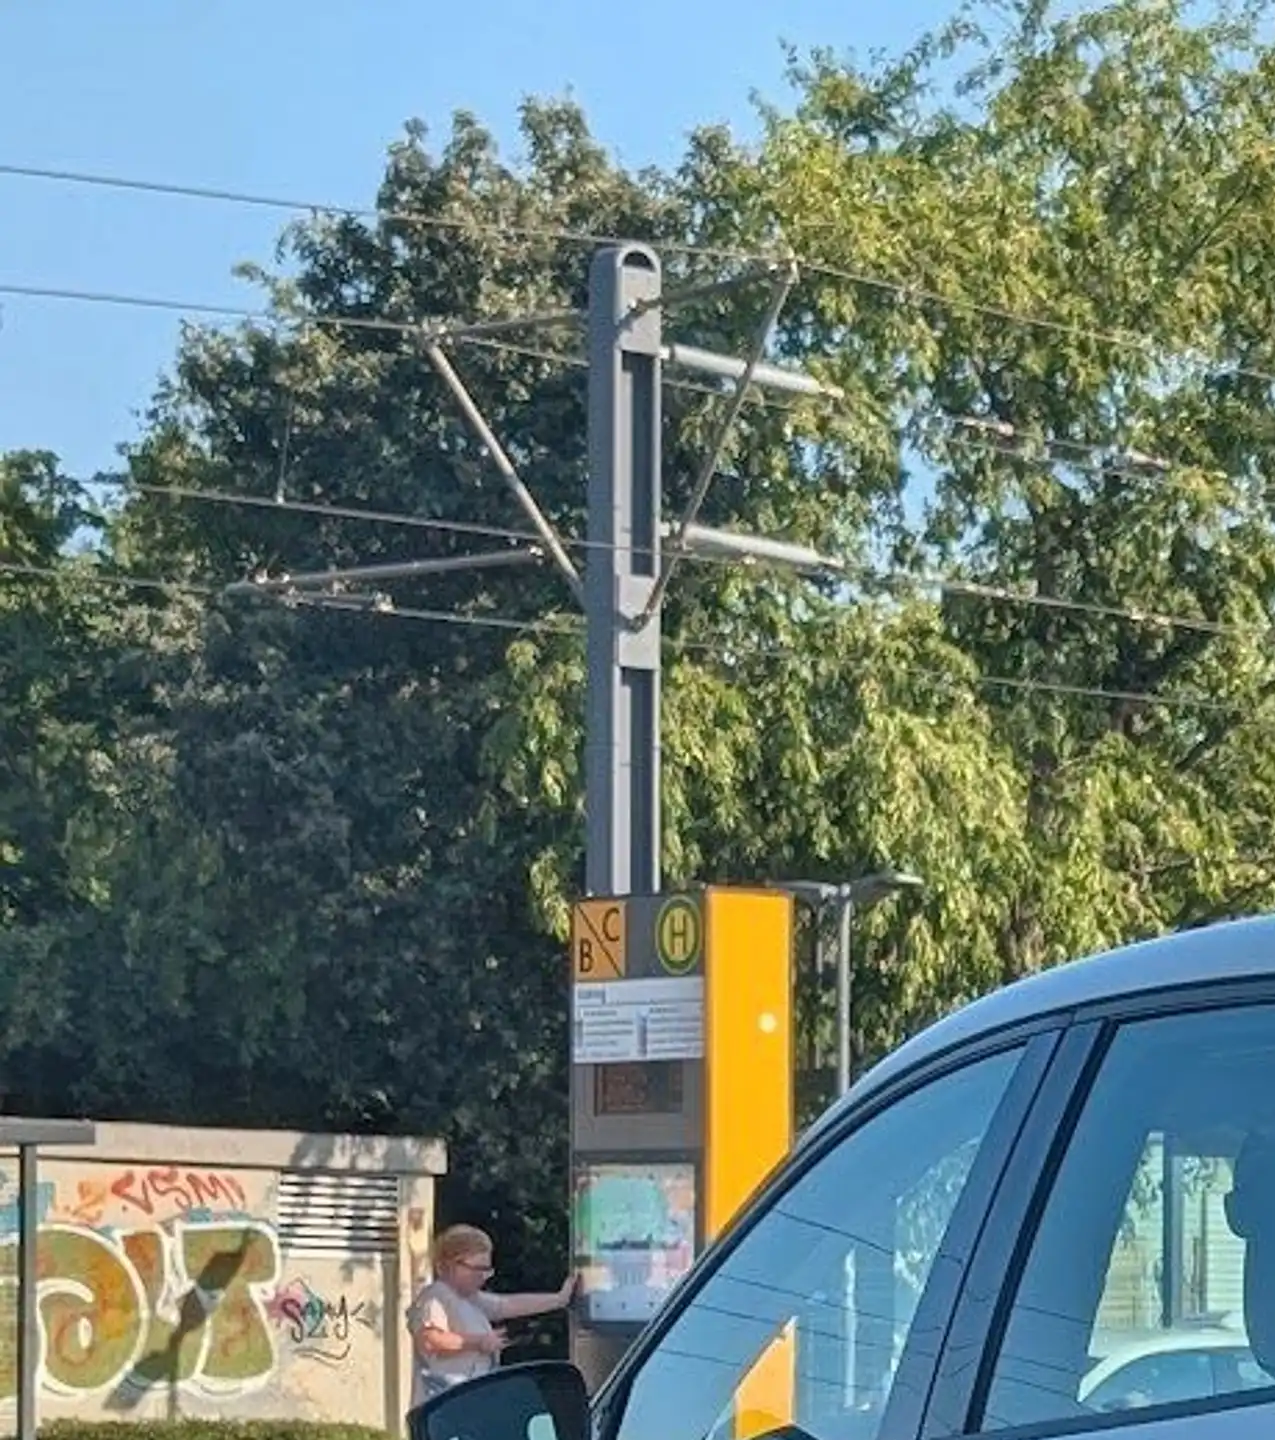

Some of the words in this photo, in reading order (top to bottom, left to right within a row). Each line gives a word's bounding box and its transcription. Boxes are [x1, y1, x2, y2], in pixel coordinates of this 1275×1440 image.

[602, 907, 620, 942] C
[670, 914, 687, 956] H
[579, 938, 594, 973] B
